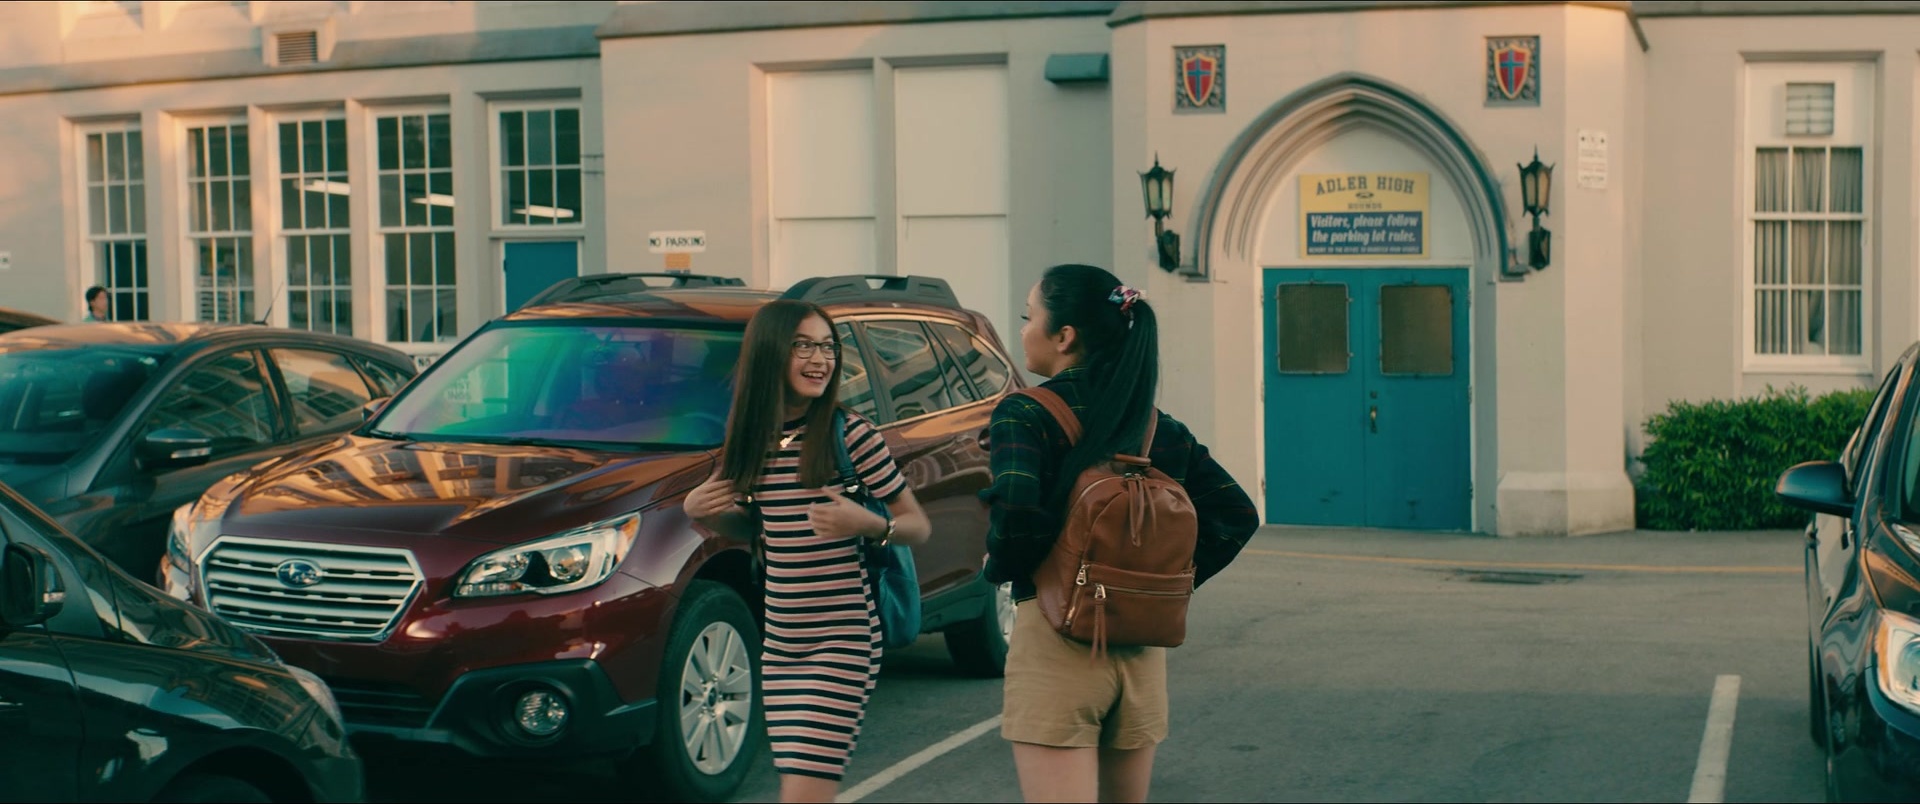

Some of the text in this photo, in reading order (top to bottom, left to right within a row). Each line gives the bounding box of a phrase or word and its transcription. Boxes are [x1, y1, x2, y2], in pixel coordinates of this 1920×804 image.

[1316, 176, 1415, 196] ADLER HIGH
[1311, 213, 1419, 229] Visitors, please follow
[649, 236, 705, 247] NO PARKING
[1312, 229, 1416, 246] the parking lot rules.
